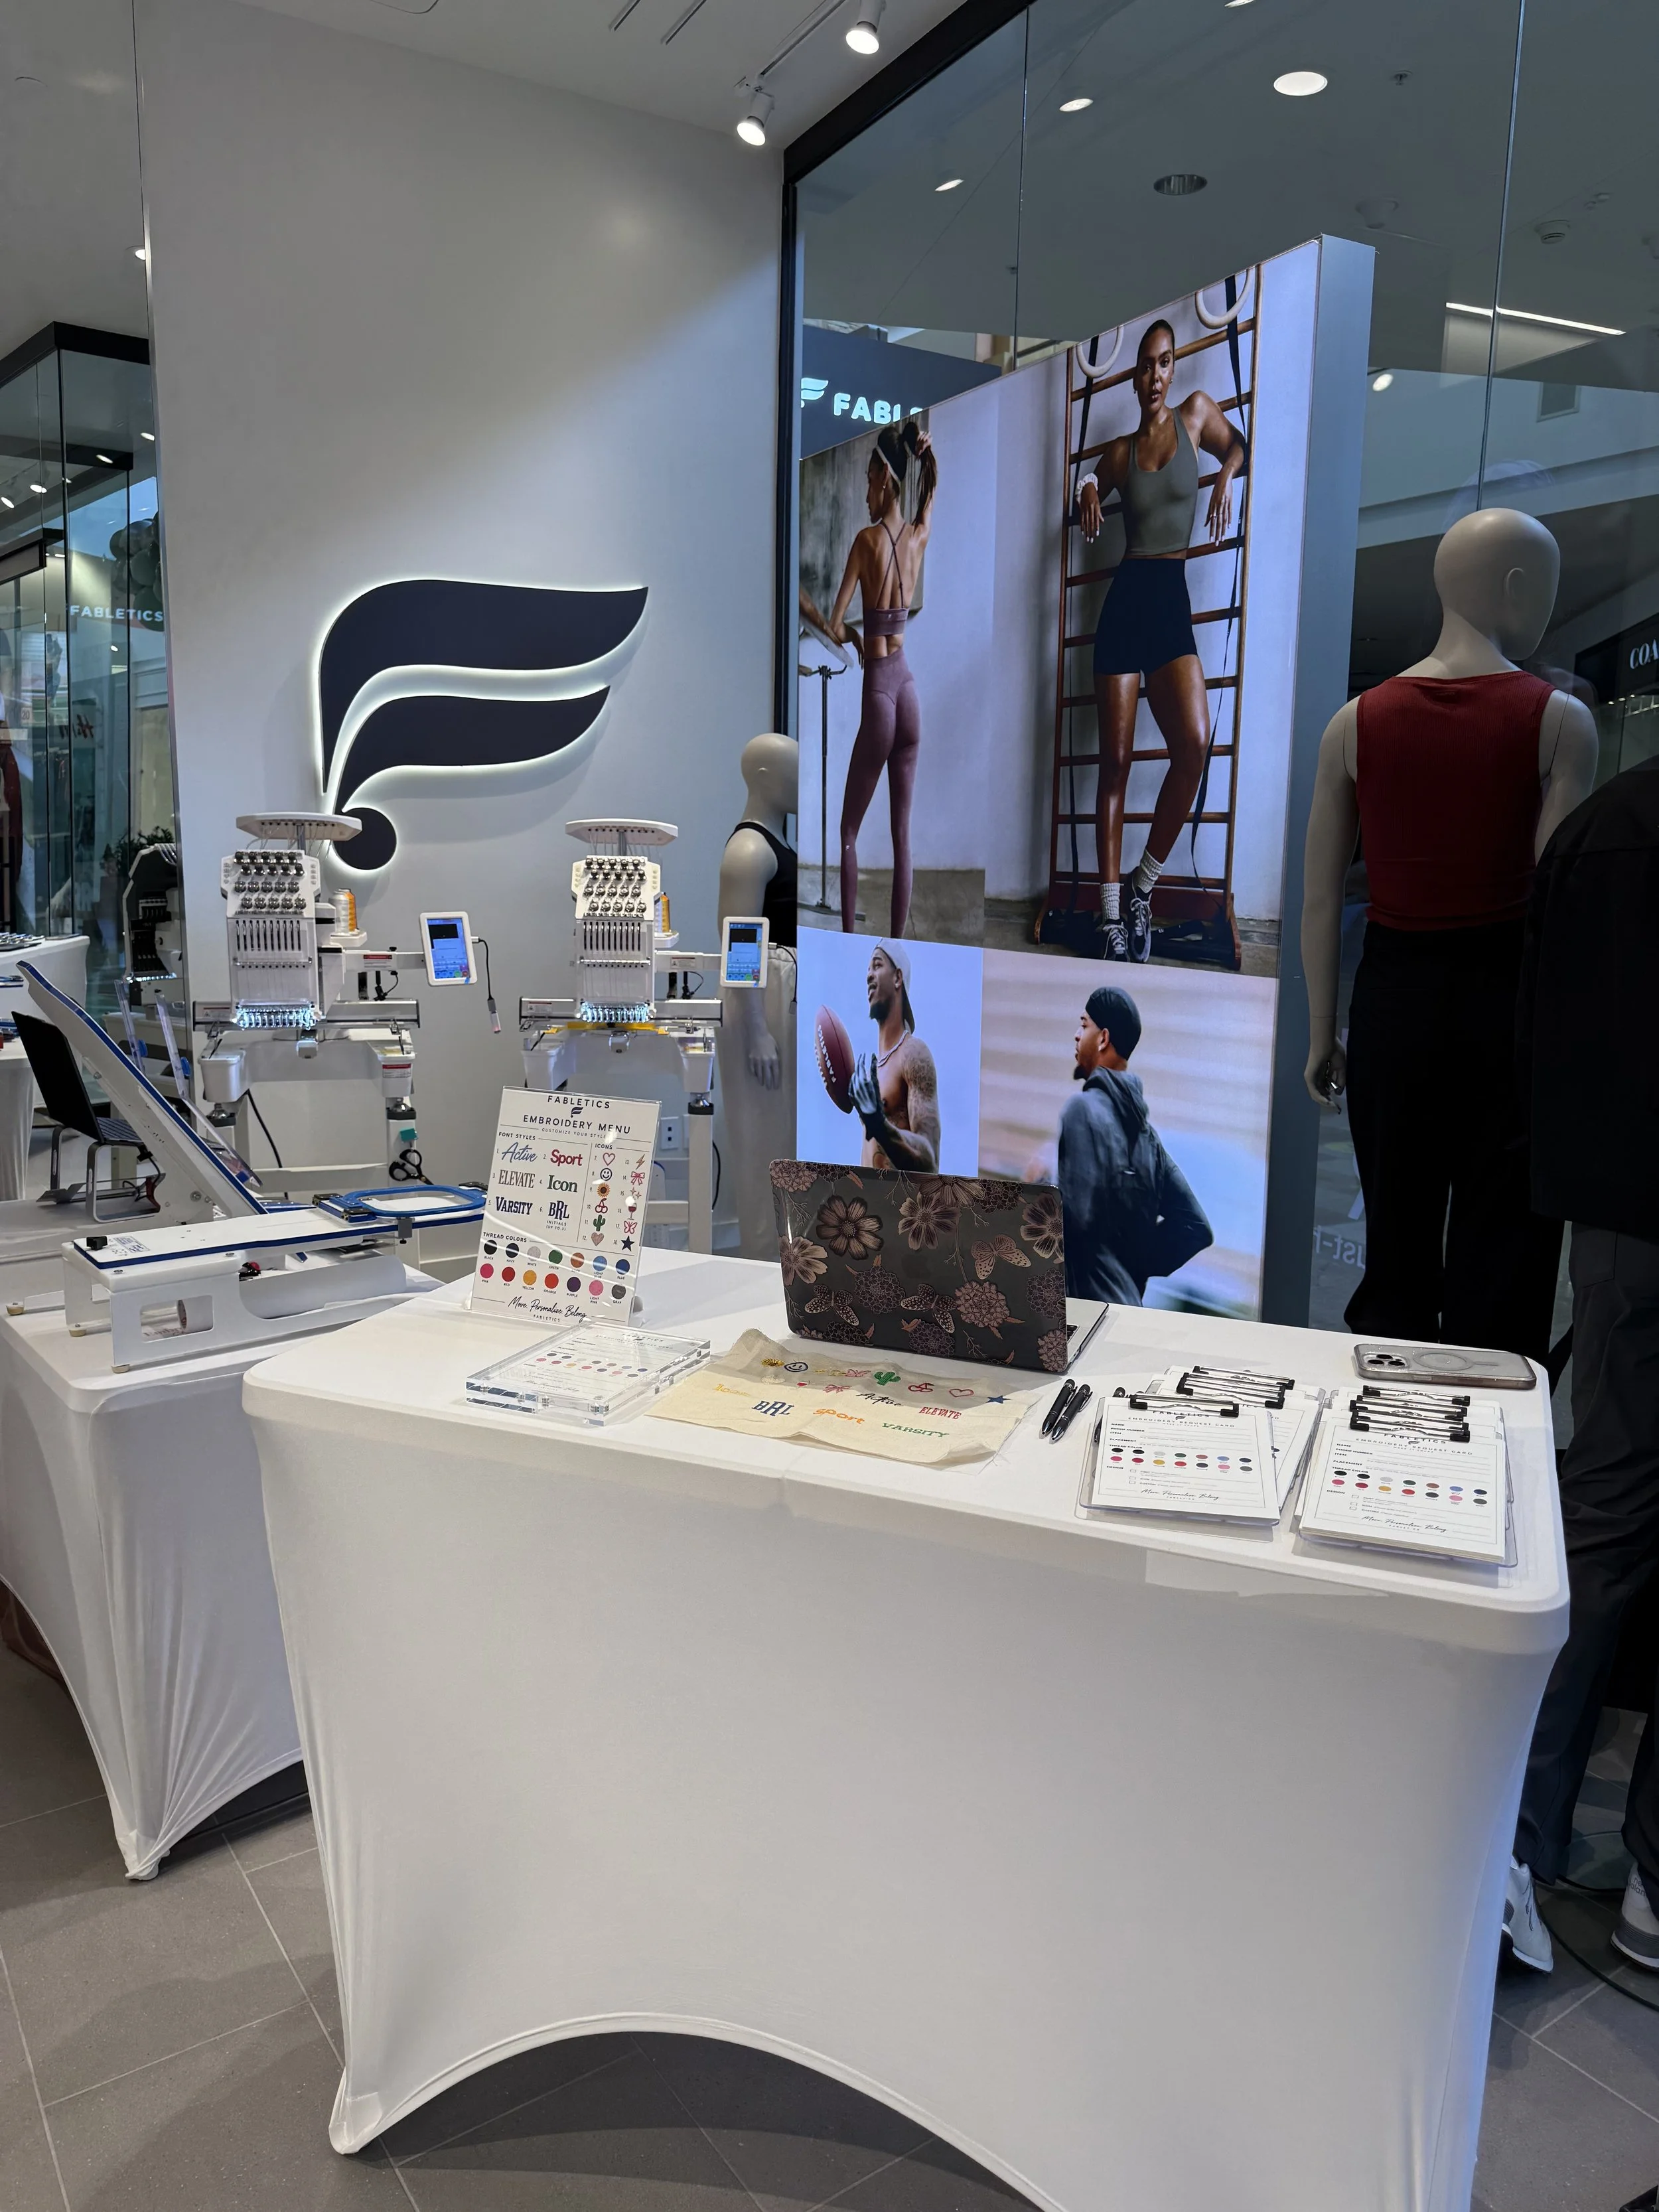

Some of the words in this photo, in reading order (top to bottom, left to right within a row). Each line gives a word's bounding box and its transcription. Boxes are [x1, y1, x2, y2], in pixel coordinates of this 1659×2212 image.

[833, 392, 923, 424] FABL
[69, 605, 164, 622] FABLETICS
[547, 1096, 611, 1109] FABLETICS
[523, 1115, 593, 1130] EMBROIDERY
[598, 1123, 631, 1134] MENU
[501, 1142, 538, 1163] Active
[549, 1149, 583, 1167] Sport
[498, 1169, 536, 1189] ELEVATE
[547, 1174, 578, 1193] Icon
[495, 1196, 533, 1215] VARSITY
[548, 1200, 570, 1220] BRL
[751, 1400, 795, 1417] BRL
[855, 1392, 904, 1408] Active
[918, 1406, 962, 1420] ELEVATE
[881, 1422, 950, 1439] VARSITY
[1356, 1438, 1408, 1447] EMBROIDERY
